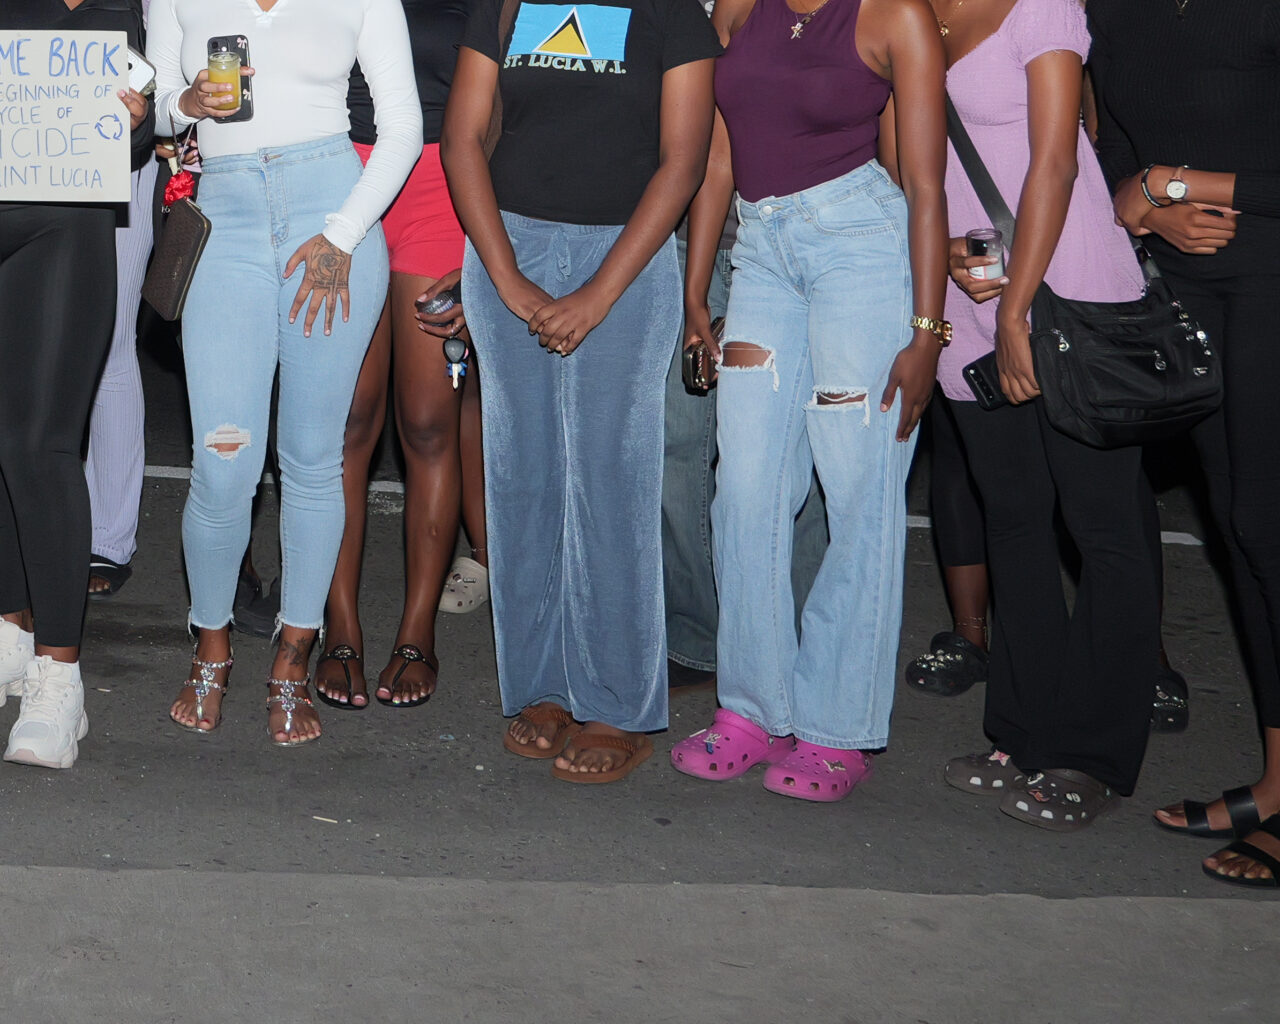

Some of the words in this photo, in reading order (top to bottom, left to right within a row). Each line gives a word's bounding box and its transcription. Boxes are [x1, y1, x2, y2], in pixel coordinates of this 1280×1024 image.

[48, 37, 120, 77] BACK
[504, 55, 523, 69] ST.
[528, 55, 586, 72] LUCIA
[591, 59, 627, 74] W.I.
[94, 84, 113, 98] OF
[57, 107, 73, 119] OF
[49, 166, 103, 189] LUCIA
